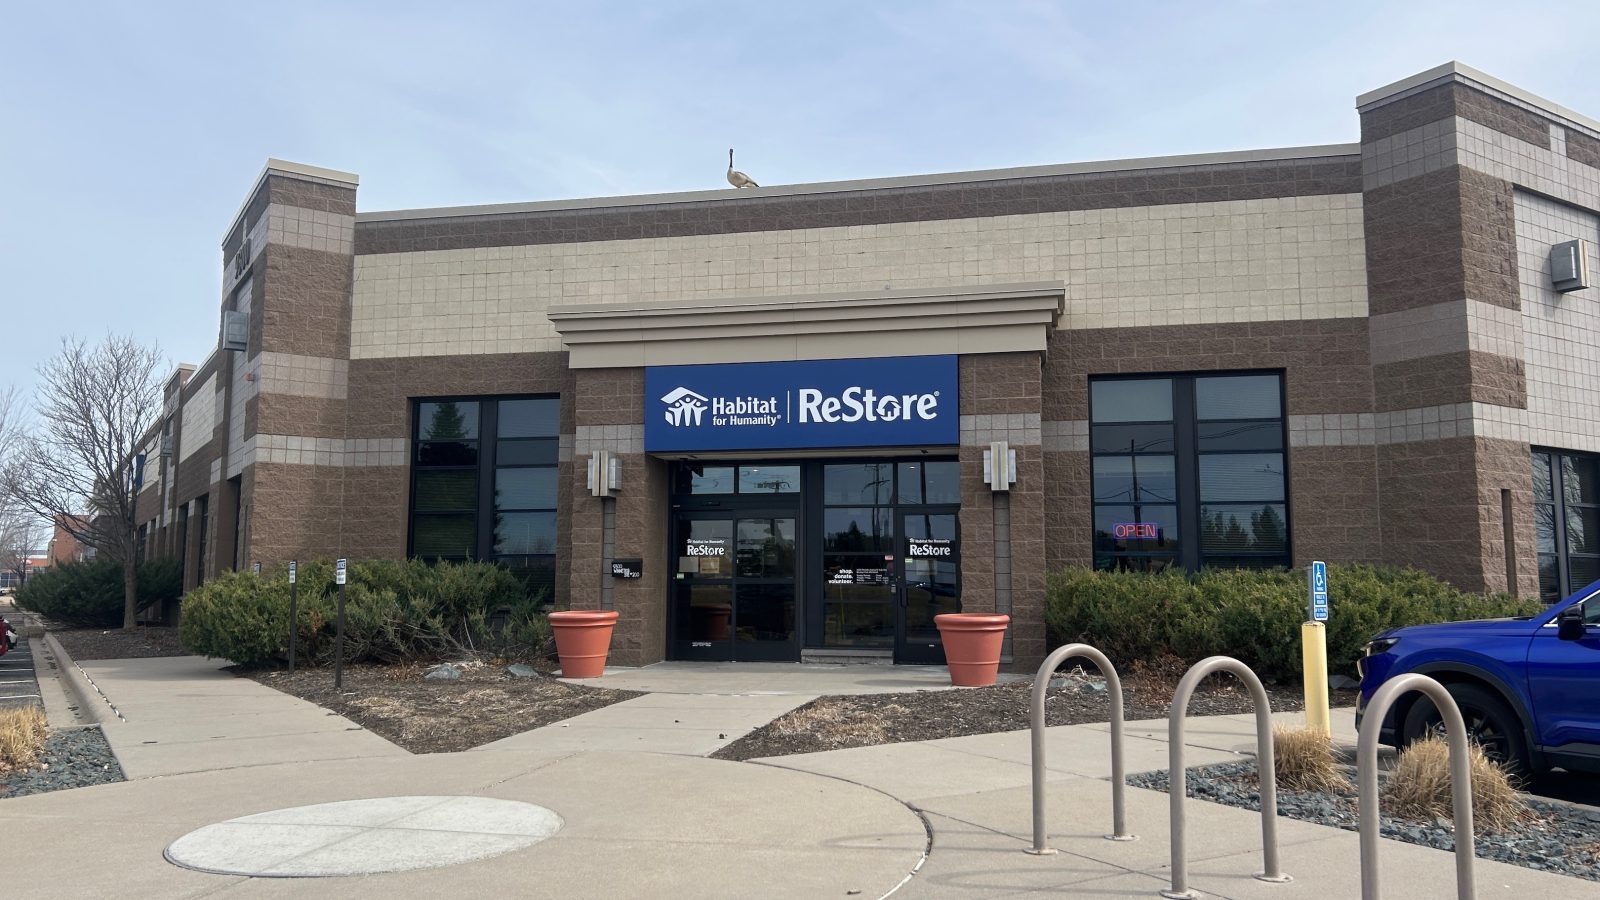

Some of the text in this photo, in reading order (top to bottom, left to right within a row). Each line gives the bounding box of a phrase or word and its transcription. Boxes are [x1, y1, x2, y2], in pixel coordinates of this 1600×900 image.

[712, 396, 777, 415] Habitat
[712, 415, 726, 426] for
[1115, 524, 1155, 537] OPEN
[687, 545, 725, 555] ReStore
[910, 544, 950, 555] ReStore
